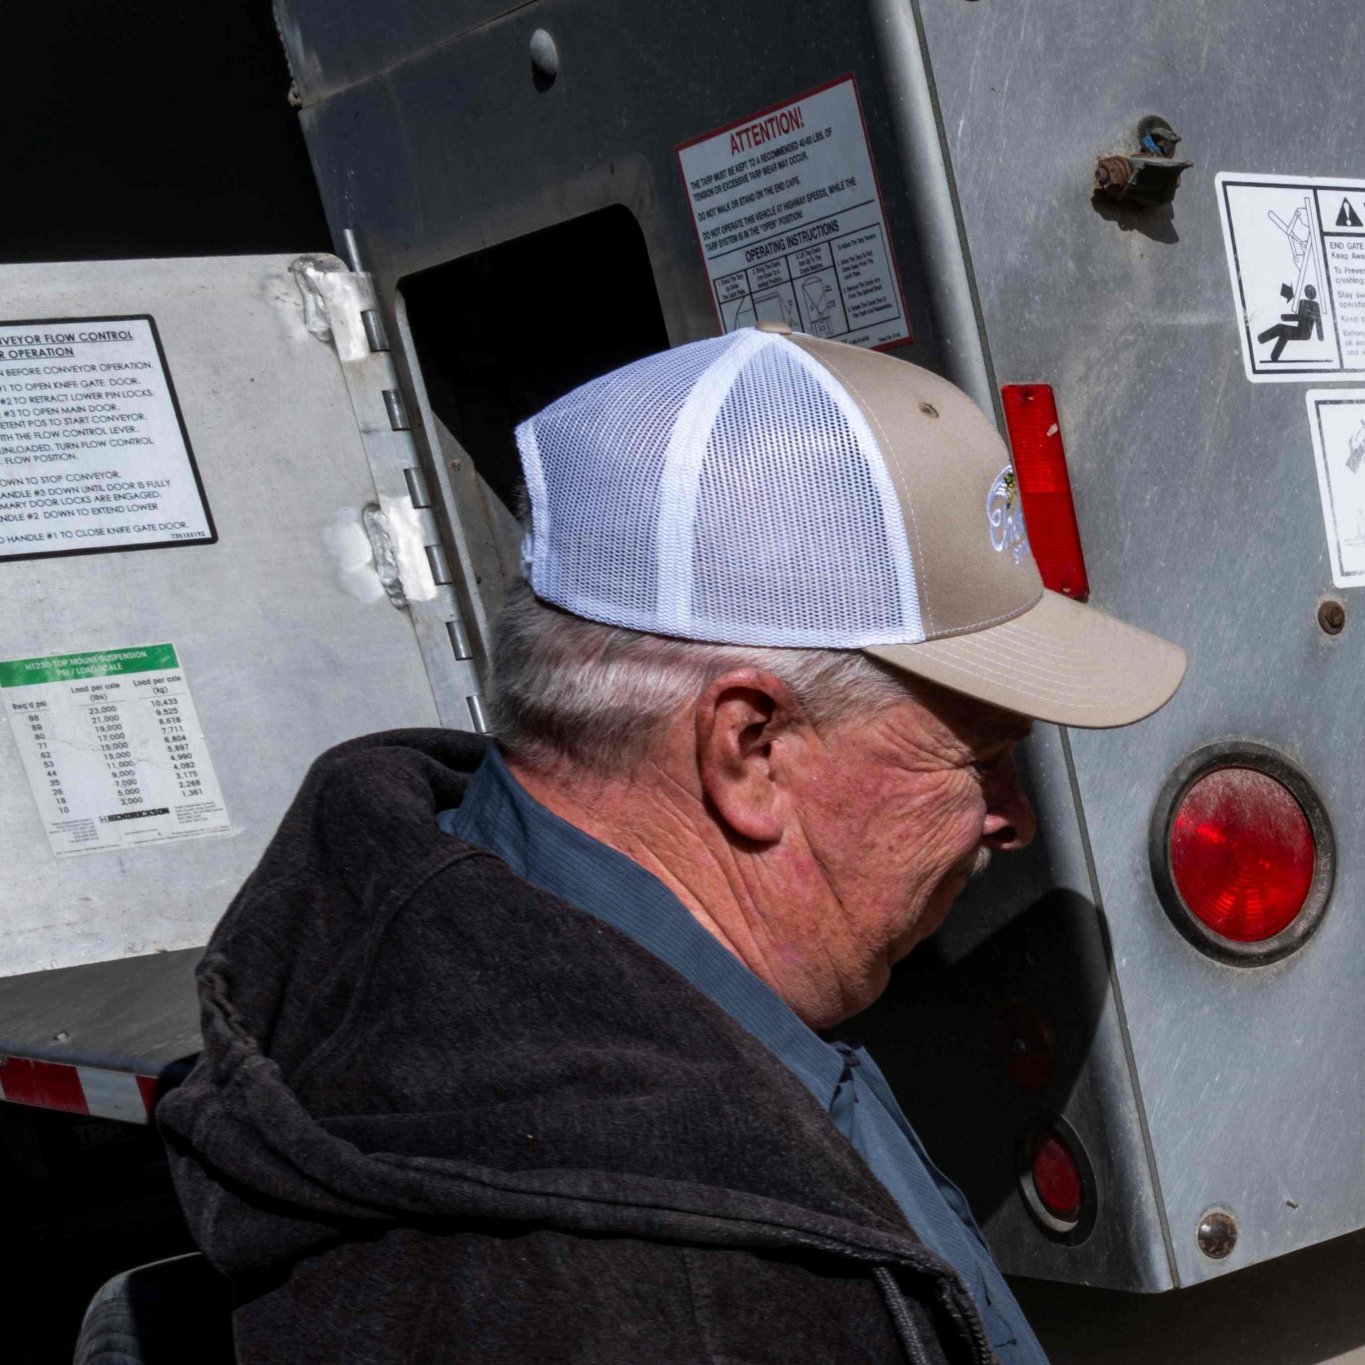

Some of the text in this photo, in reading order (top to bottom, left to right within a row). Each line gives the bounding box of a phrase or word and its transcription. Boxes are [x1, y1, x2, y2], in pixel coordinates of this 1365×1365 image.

[730, 106, 804, 155] ATTENTION!
[746, 238, 786, 262] OPERATING
[786, 220, 839, 248] INSTRUCTIONS
[1331, 252, 1348, 260] Keep
[1338, 291, 1352, 299] Stay
[44, 333, 75, 343] FLOW
[79, 331, 133, 342] CONTROL
[8, 347, 74, 358] OPERATION
[6, 368, 41, 376] BEFORE
[43, 364, 97, 374] CONVEYOR
[10, 384, 22, 392] TO
[25, 382, 51, 391] OPEN
[80, 379, 105, 388] GATE
[29, 394, 68, 404] RETRACT
[71, 393, 103, 401] LOWER
[105, 391, 121, 399] PIN
[33, 408, 59, 416] OPEN
[28, 420, 48, 428] POS
[49, 418, 62, 426] TO
[64, 417, 89, 425] START
[34, 431, 60, 439] FLOW
[63, 428, 108, 438] CONTROL
[110, 437, 155, 447] CONTROL
[5, 456, 31, 464] FLOW
[40, 475, 62, 484] STOP
[48, 486, 80, 495] DOWN
[81, 485, 106, 493] UNTIL
[107, 482, 135, 490] DOOR
[147, 480, 170, 488] FULLY
[30, 499, 59, 508] DOOR
[61, 496, 92, 505] LOCKS
[94, 494, 112, 503] ARE
[44, 510, 75, 519] DOWN
[76, 508, 89, 516] TO
[91, 506, 125, 515] EXTEND
[127, 503, 159, 512] LOWER
[7, 533, 44, 542] HANDLE
[60, 530, 73, 538] TO
[76, 528, 105, 537] CLOSE
[133, 524, 156, 532] GATE
[107, 808, 170, 822] HENDRICKSON
